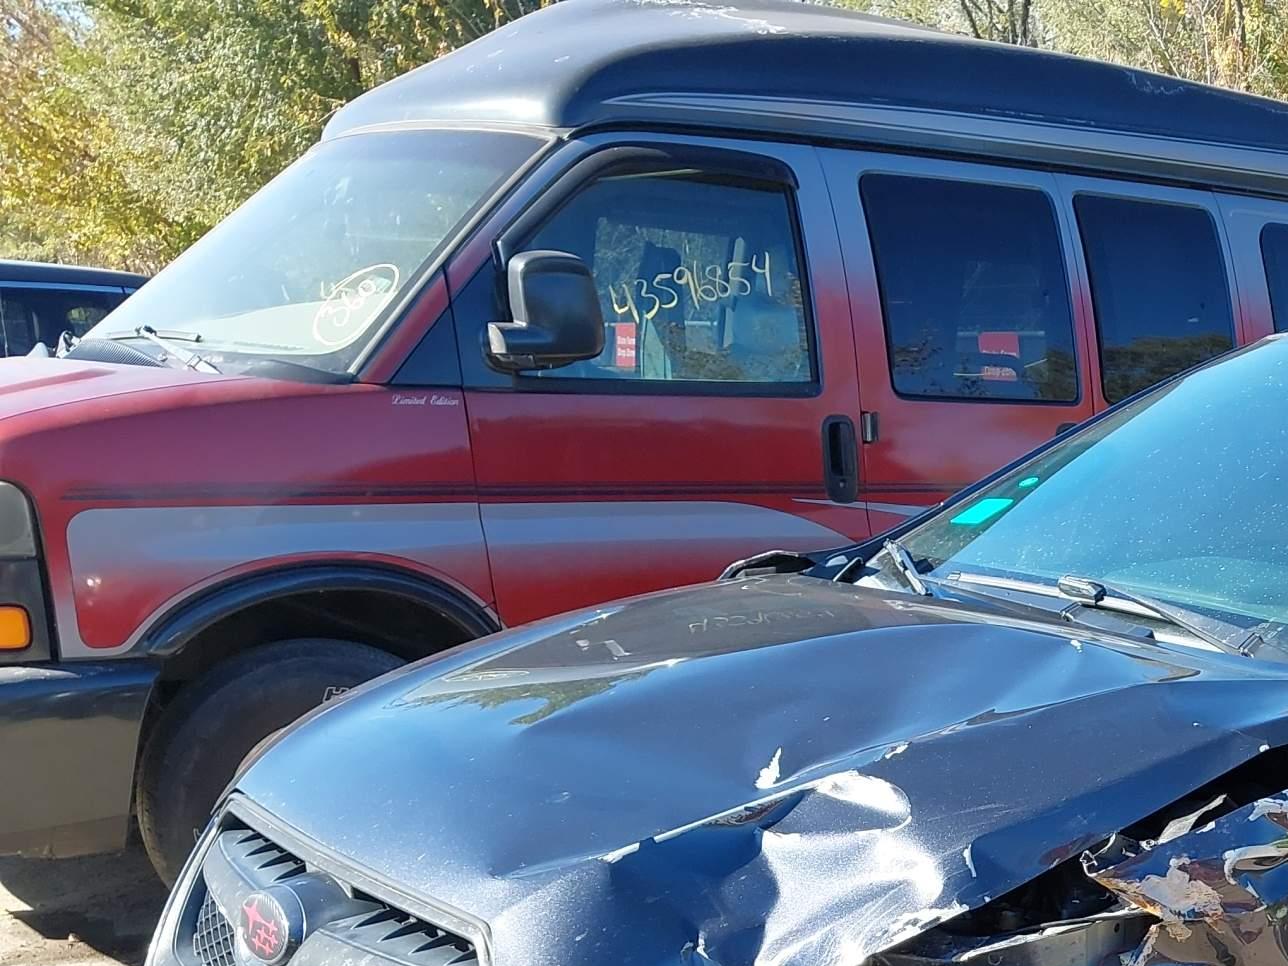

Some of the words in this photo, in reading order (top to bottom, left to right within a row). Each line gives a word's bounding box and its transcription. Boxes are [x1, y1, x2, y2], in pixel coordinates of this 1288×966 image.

[608, 251, 773, 325] 43596854
[391, 393, 427, 405] Limited
[430, 394, 459, 406] Edition
